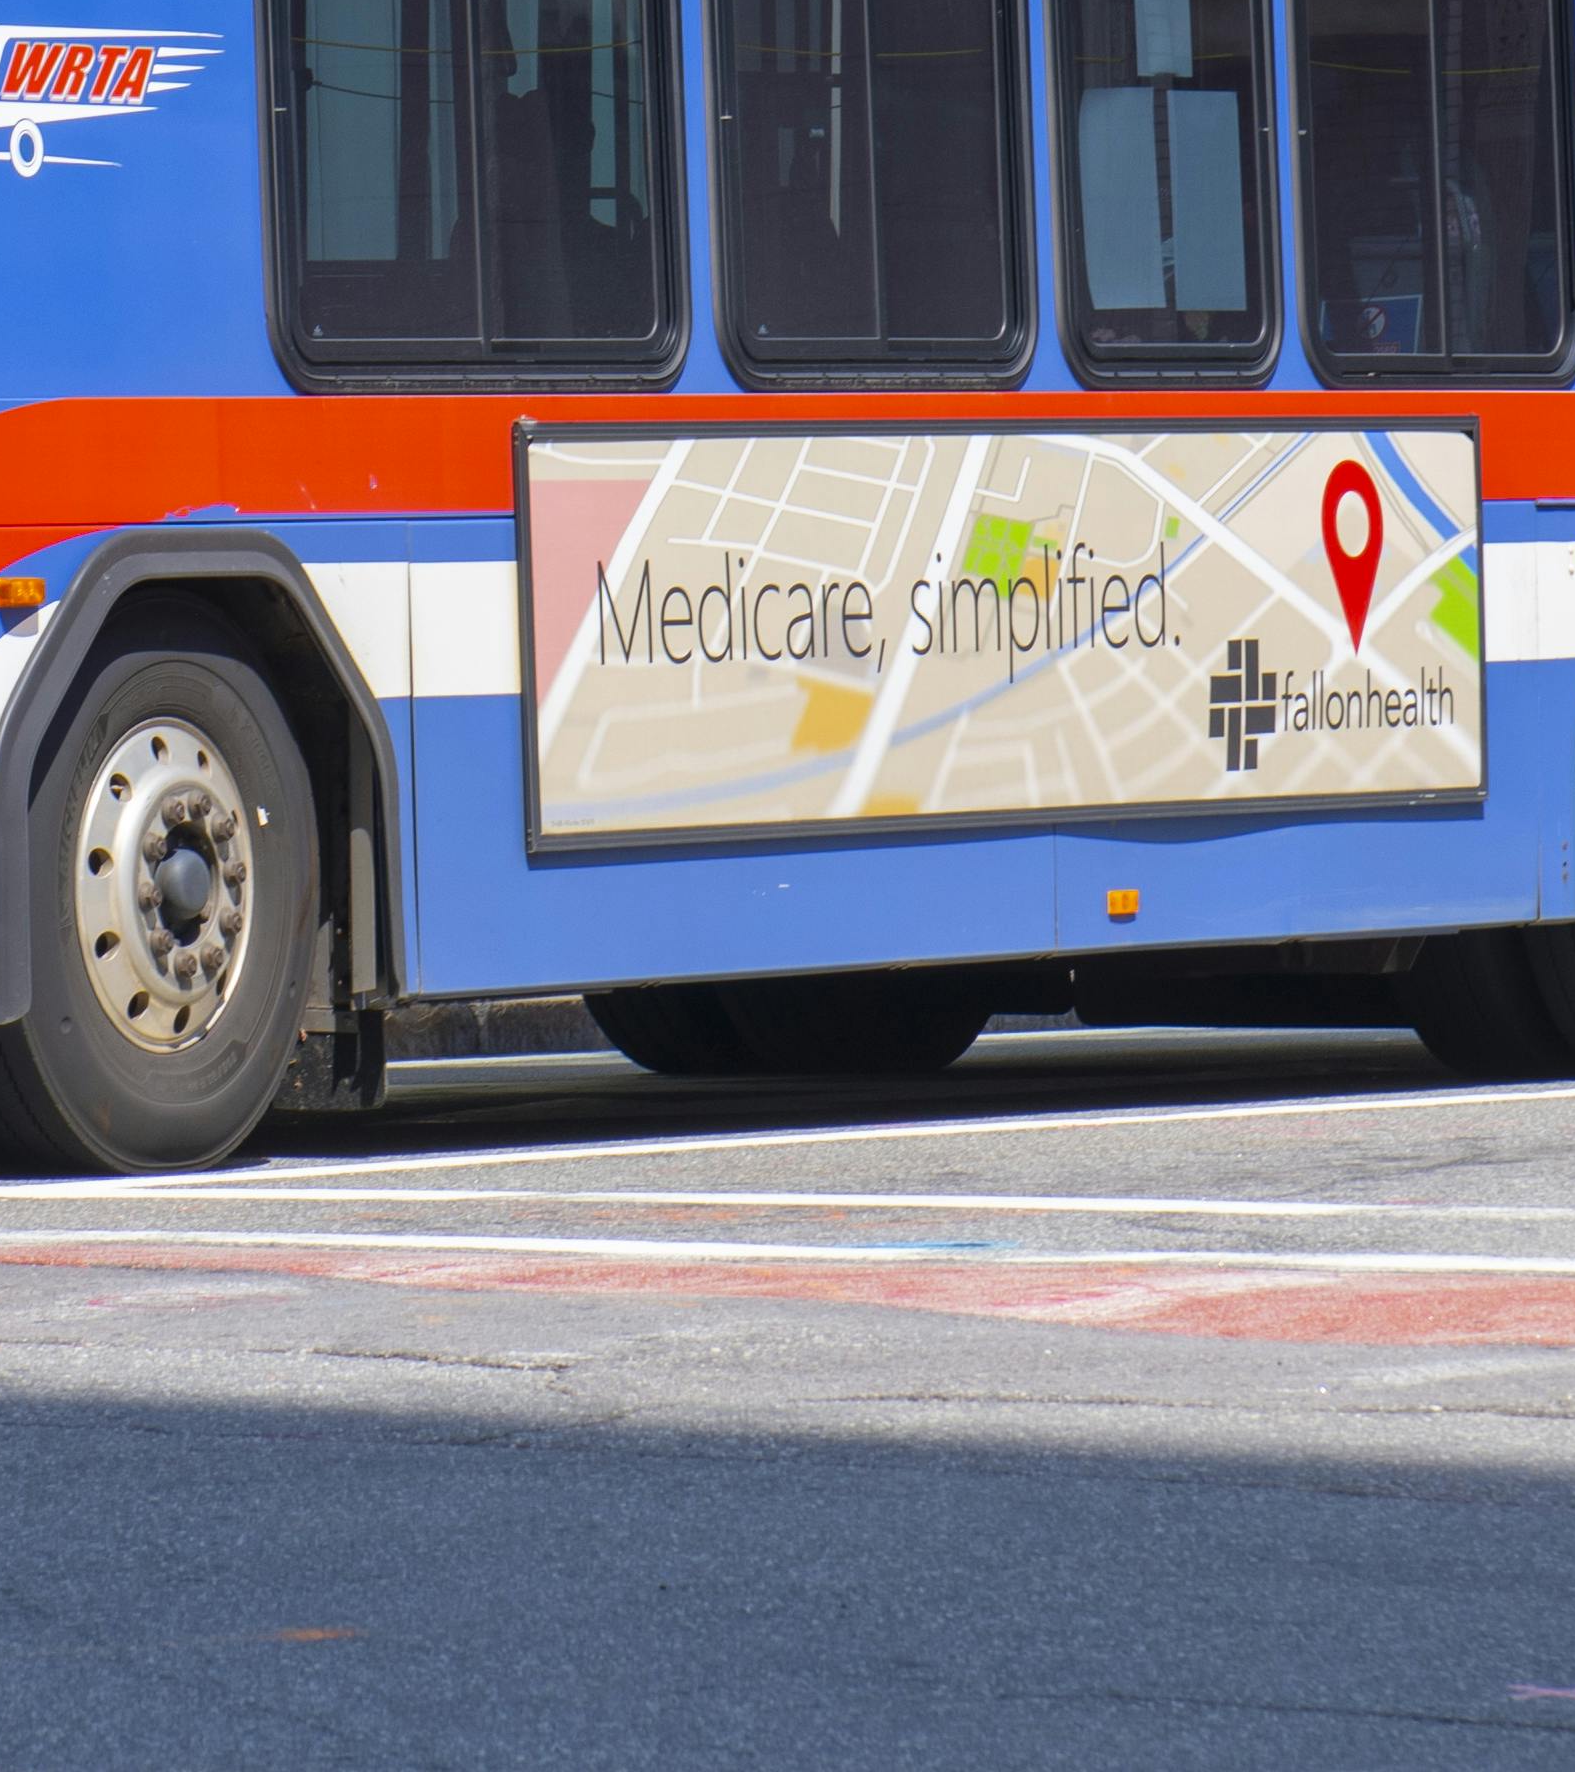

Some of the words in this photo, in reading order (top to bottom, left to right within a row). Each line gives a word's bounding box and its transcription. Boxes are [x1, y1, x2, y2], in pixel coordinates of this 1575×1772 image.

[0, 40, 157, 106] WRTA
[595, 552, 886, 674] Medicare,
[910, 541, 1183, 684] simplified.
[1281, 664, 1456, 732] fallonhealth
